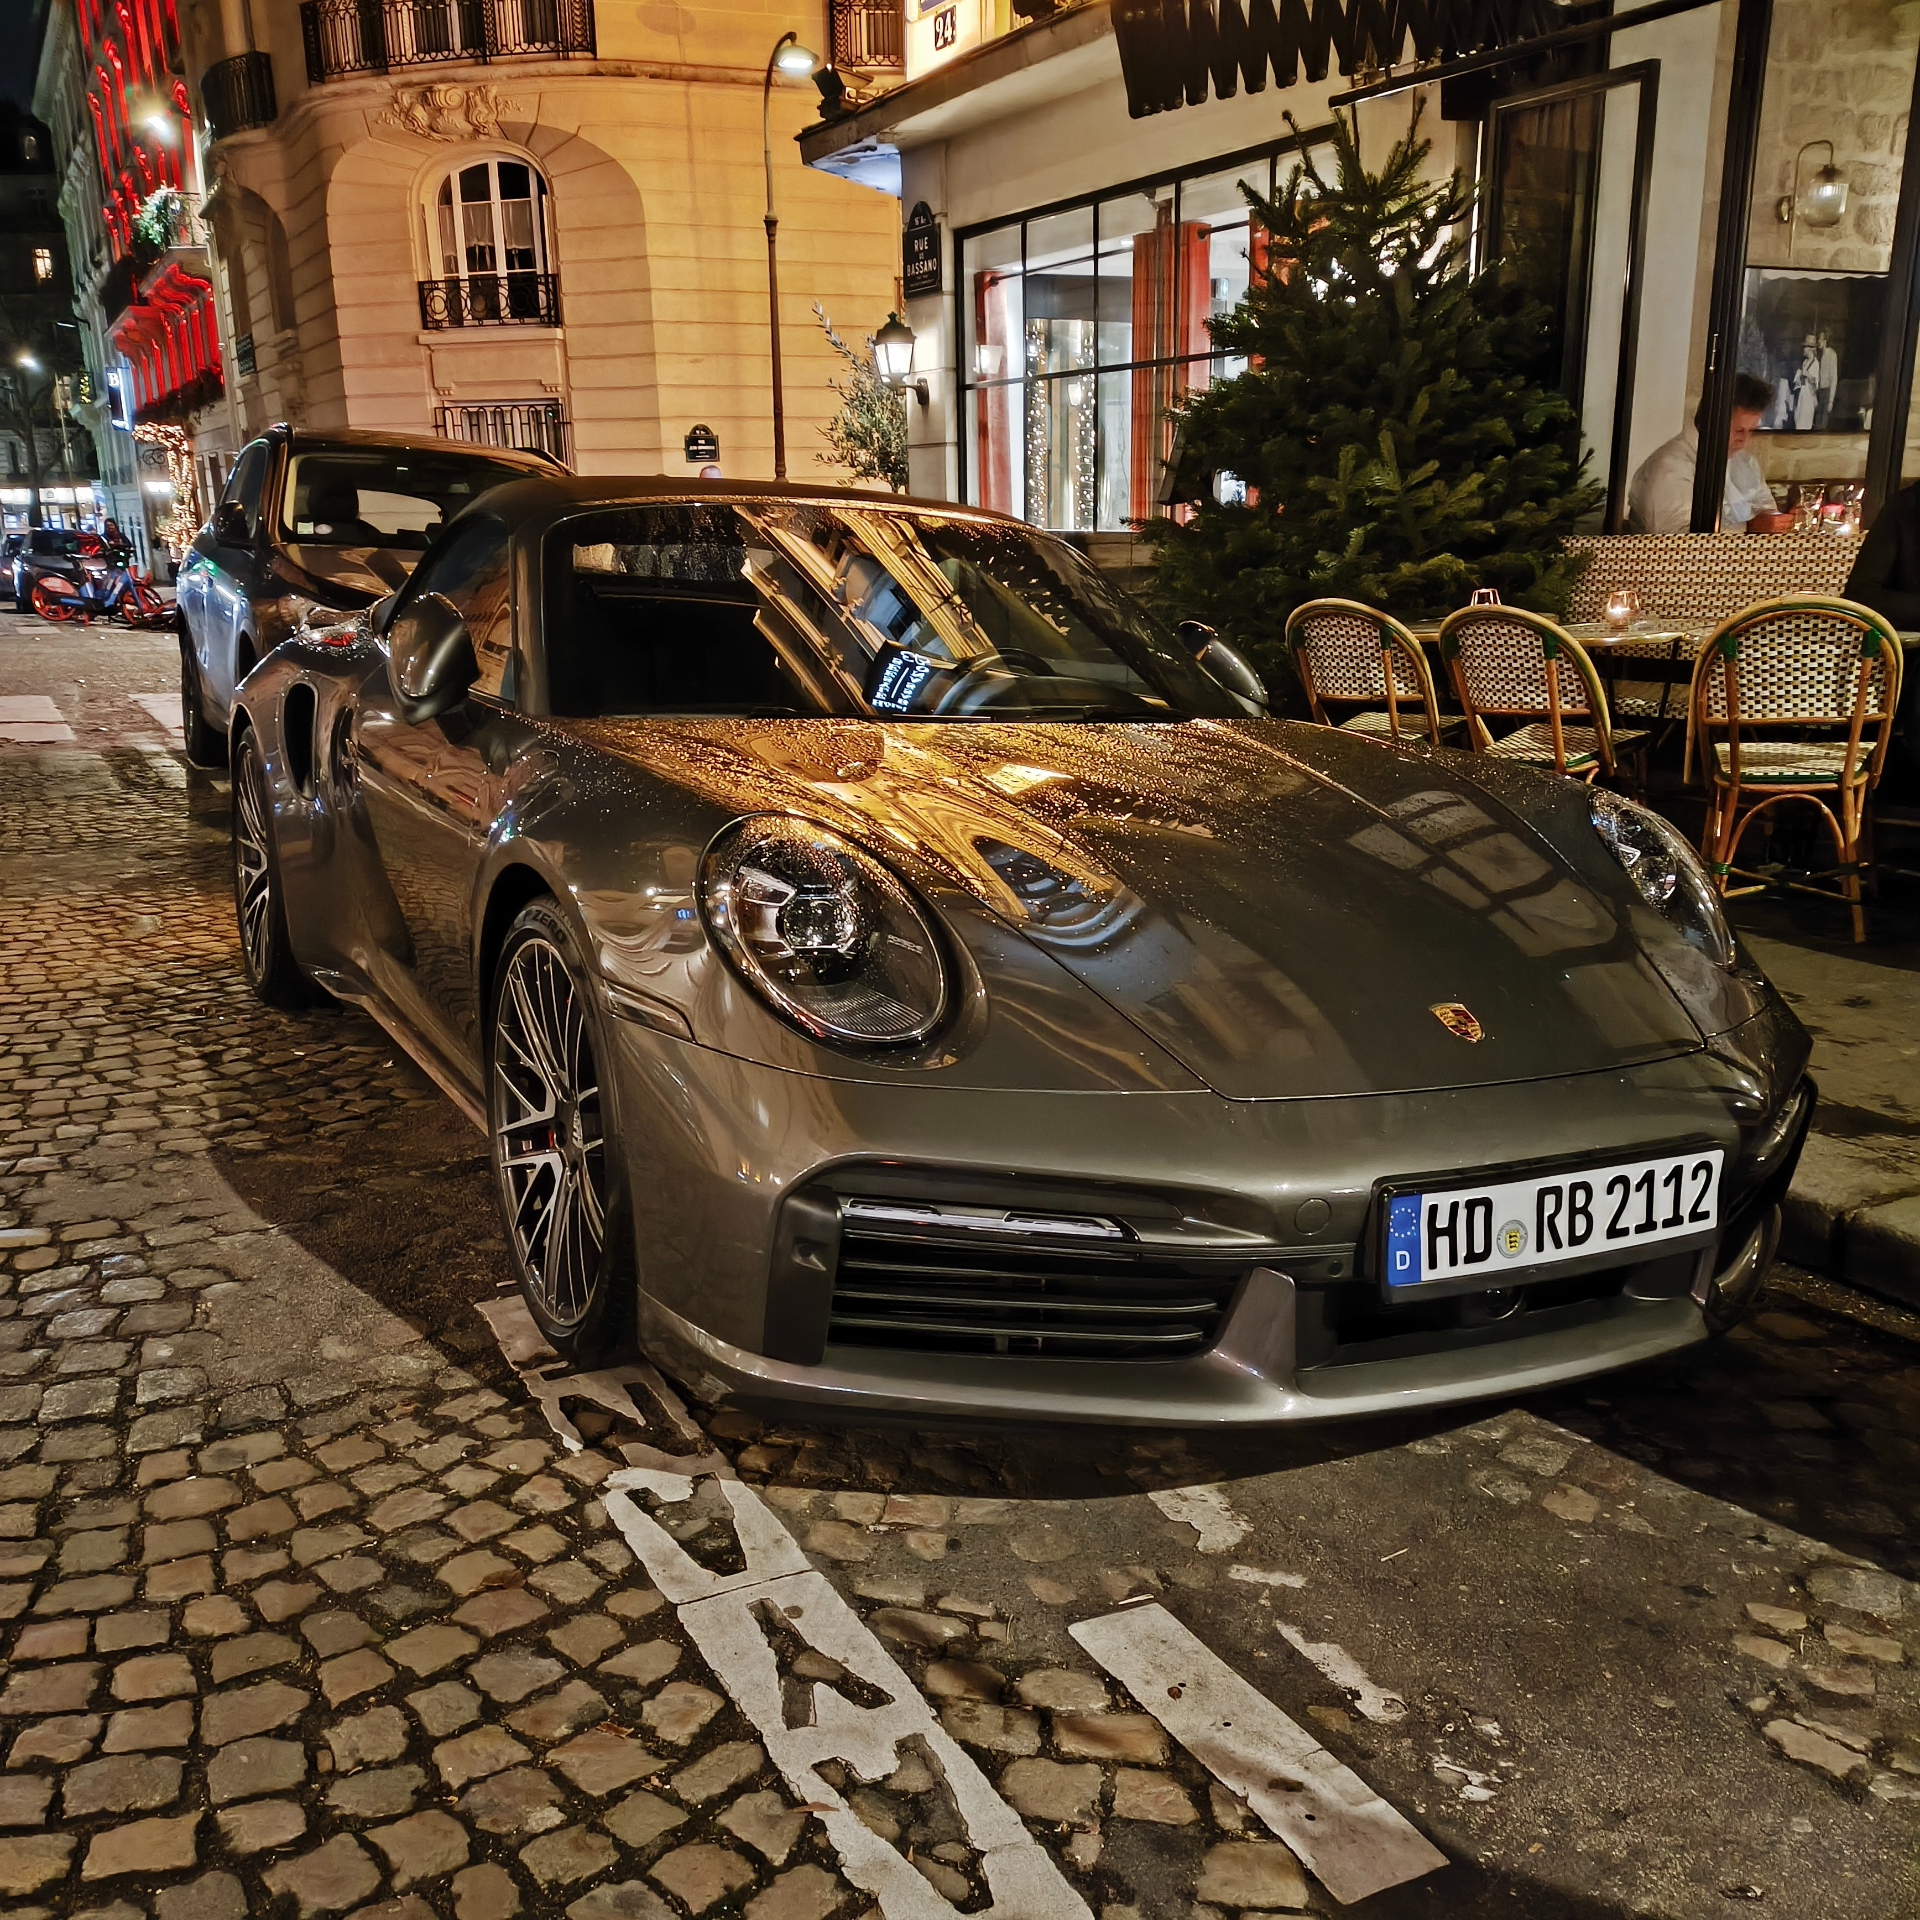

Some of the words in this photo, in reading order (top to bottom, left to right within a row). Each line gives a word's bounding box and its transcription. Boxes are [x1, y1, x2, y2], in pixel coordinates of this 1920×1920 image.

[935, 11, 952, 48] 24
[914, 236, 929, 252] RUE
[906, 257, 938, 277] BASSANO
[532, 909, 567, 944] ZERO
[1427, 1195, 1494, 1270] HD
[1535, 1180, 1594, 1253] RB
[1606, 1159, 1715, 1240] 2112
[1395, 1249, 1411, 1271] D
